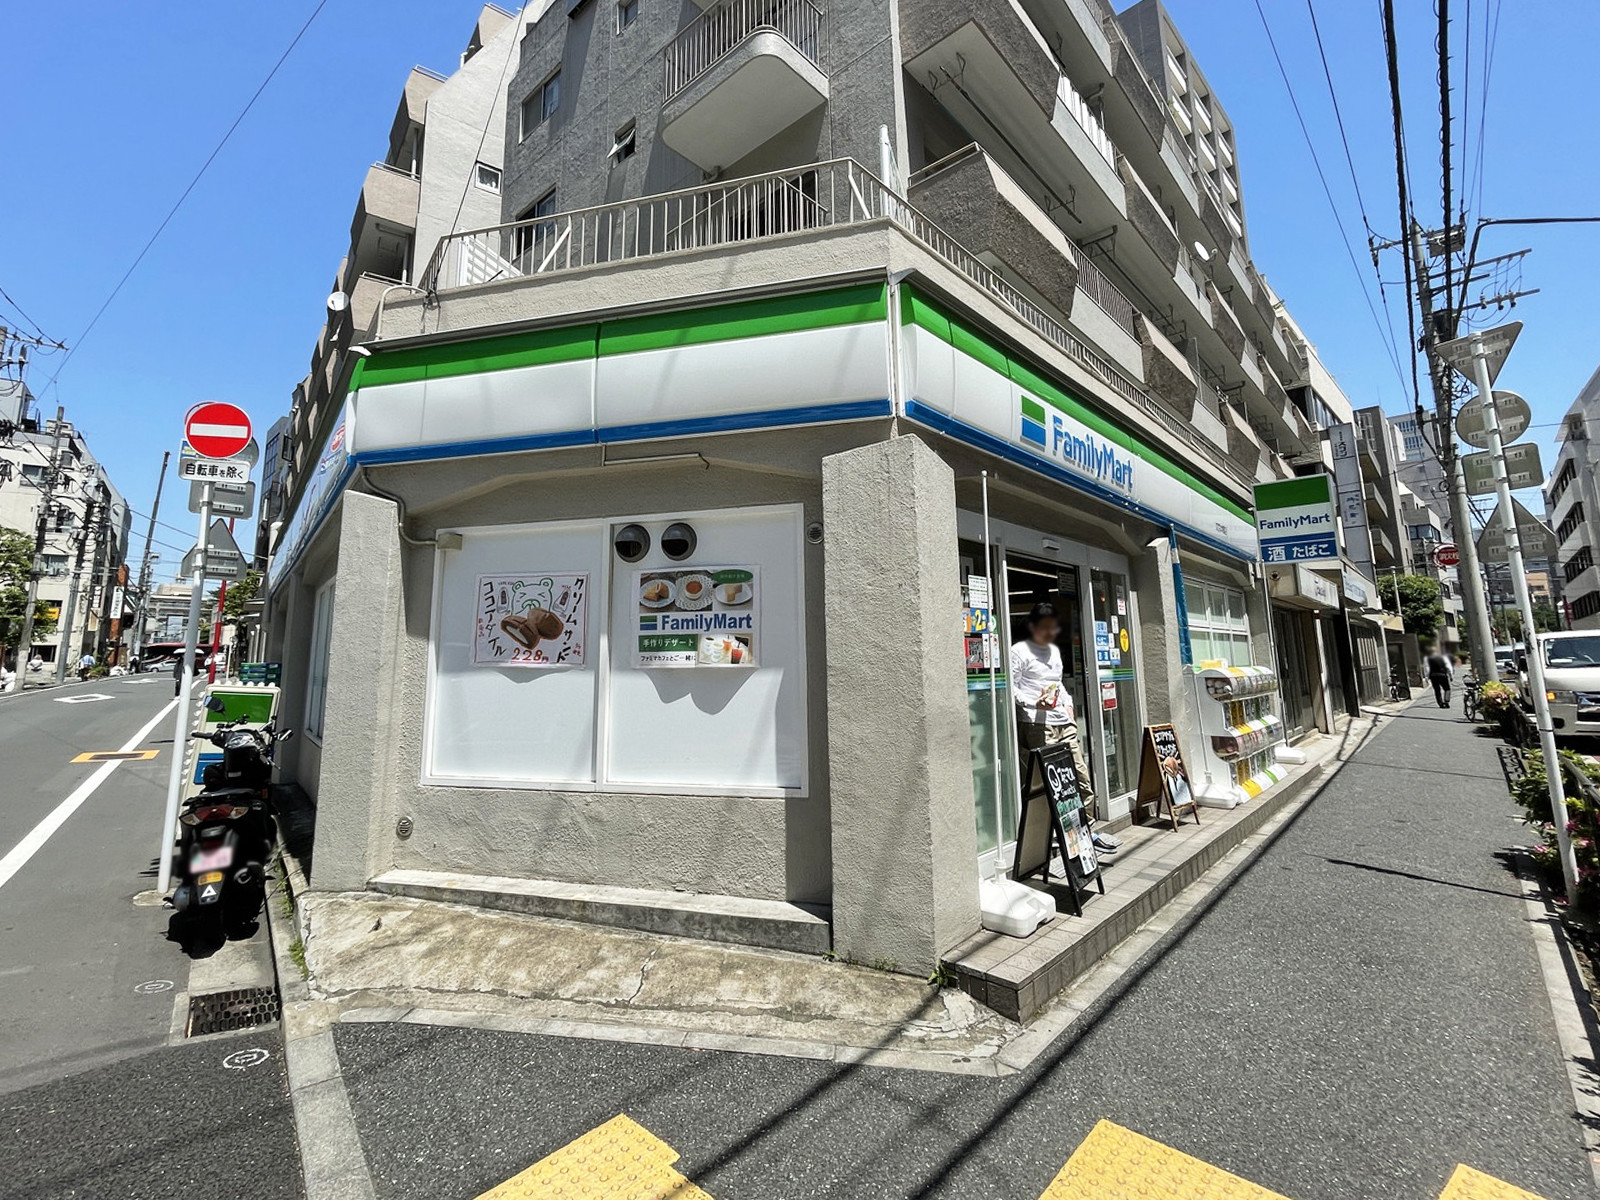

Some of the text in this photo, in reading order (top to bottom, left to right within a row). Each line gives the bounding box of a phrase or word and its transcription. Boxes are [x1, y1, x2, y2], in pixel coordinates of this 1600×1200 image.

[1052, 415, 1134, 490] FamilyMart
[185, 463, 244, 479] 自転車を除く
[1260, 513, 1331, 530] FamilyMart
[1268, 543, 1331, 561] 酒 たばこ
[661, 613, 752, 632] FamilyMart
[642, 638, 694, 648] 手作りデザート
